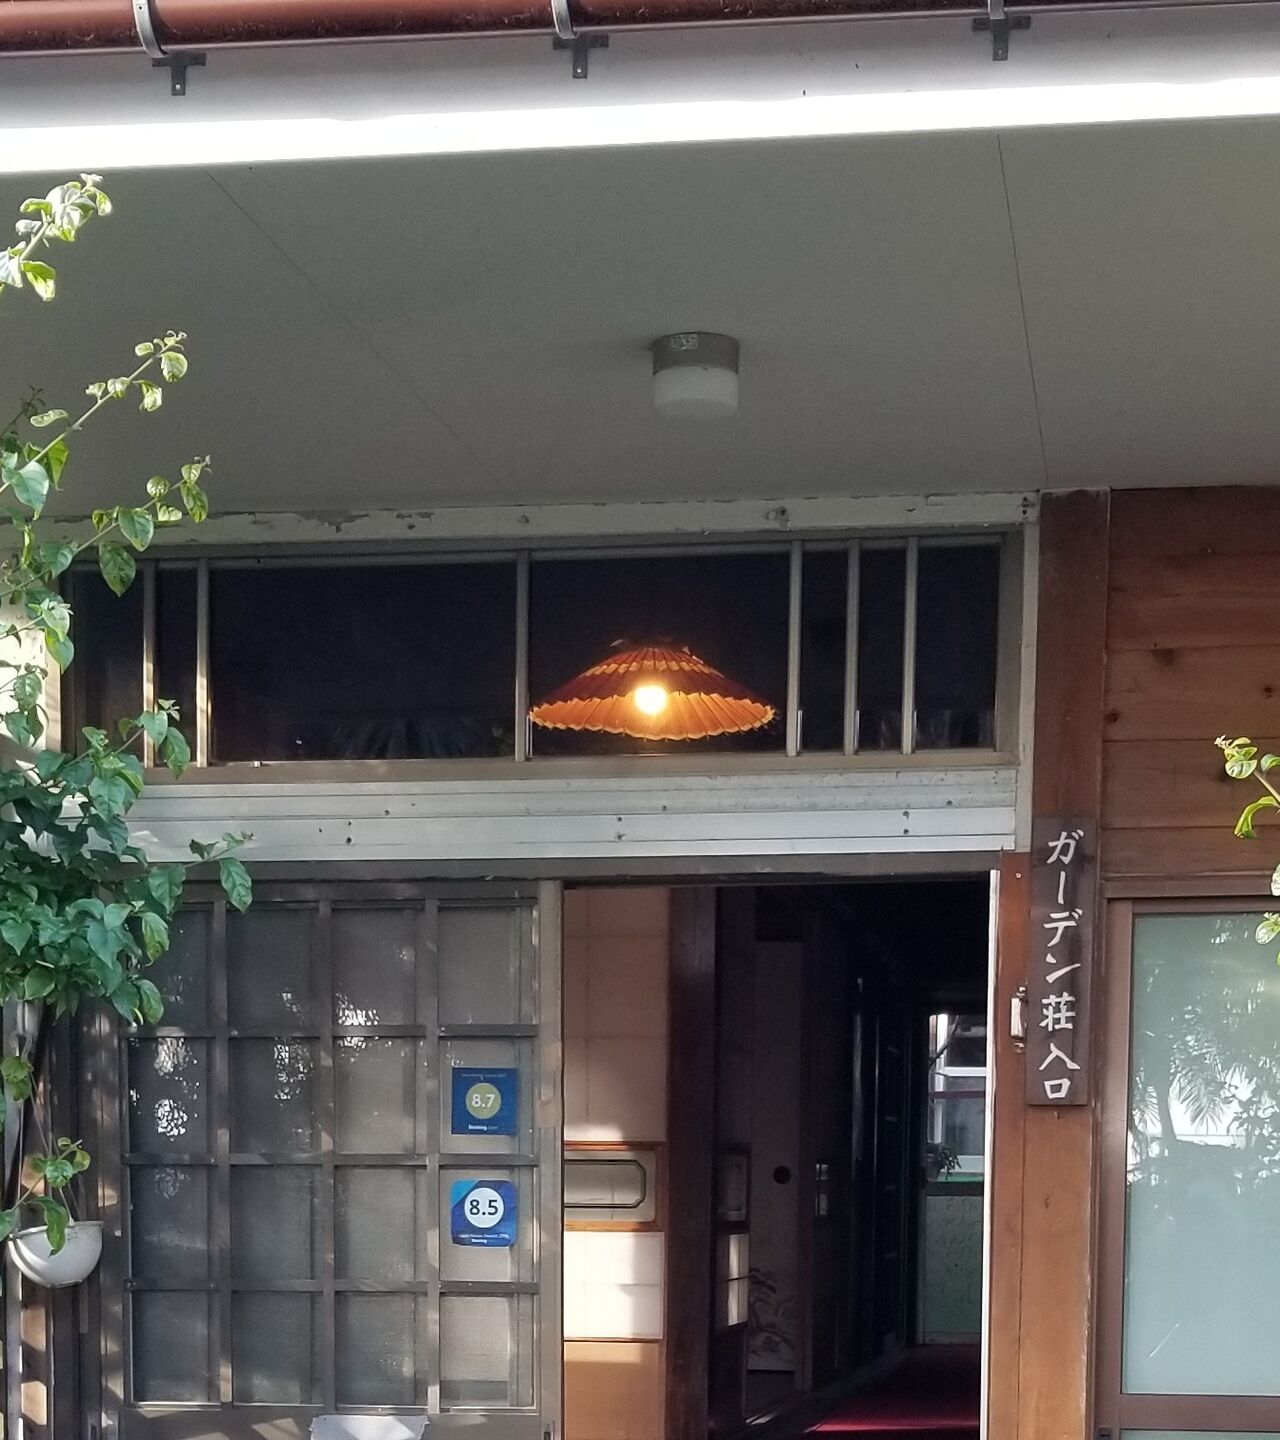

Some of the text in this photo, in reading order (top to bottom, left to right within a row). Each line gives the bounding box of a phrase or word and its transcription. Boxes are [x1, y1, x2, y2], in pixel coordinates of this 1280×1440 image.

[1038, 828, 1085, 1100] ガーデン荘入口
[471, 1093, 496, 1108] 8.7
[469, 1199, 498, 1216] 8.5
